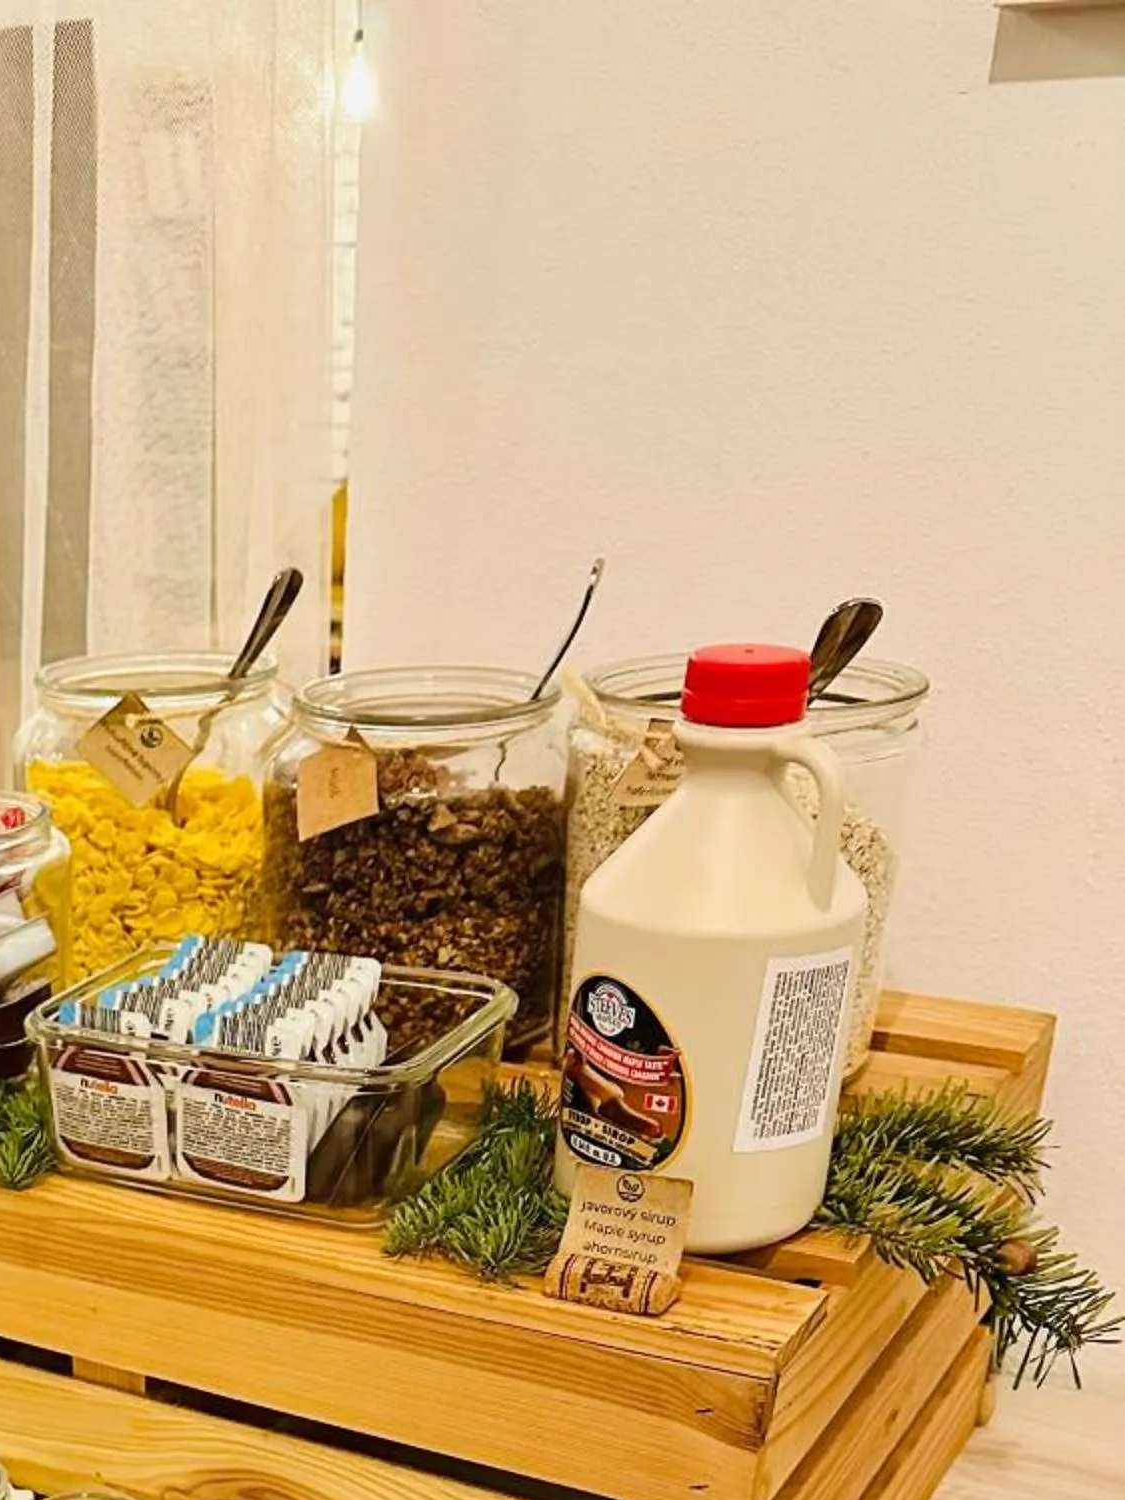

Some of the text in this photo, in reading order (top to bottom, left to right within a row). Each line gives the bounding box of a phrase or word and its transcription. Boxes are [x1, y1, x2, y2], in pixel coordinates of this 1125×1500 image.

[80, 1078, 118, 1095] nutella
[214, 1093, 256, 1111] nutella
[640, 1210, 676, 1228] sirup
[583, 1219, 666, 1246] Maple syrup
